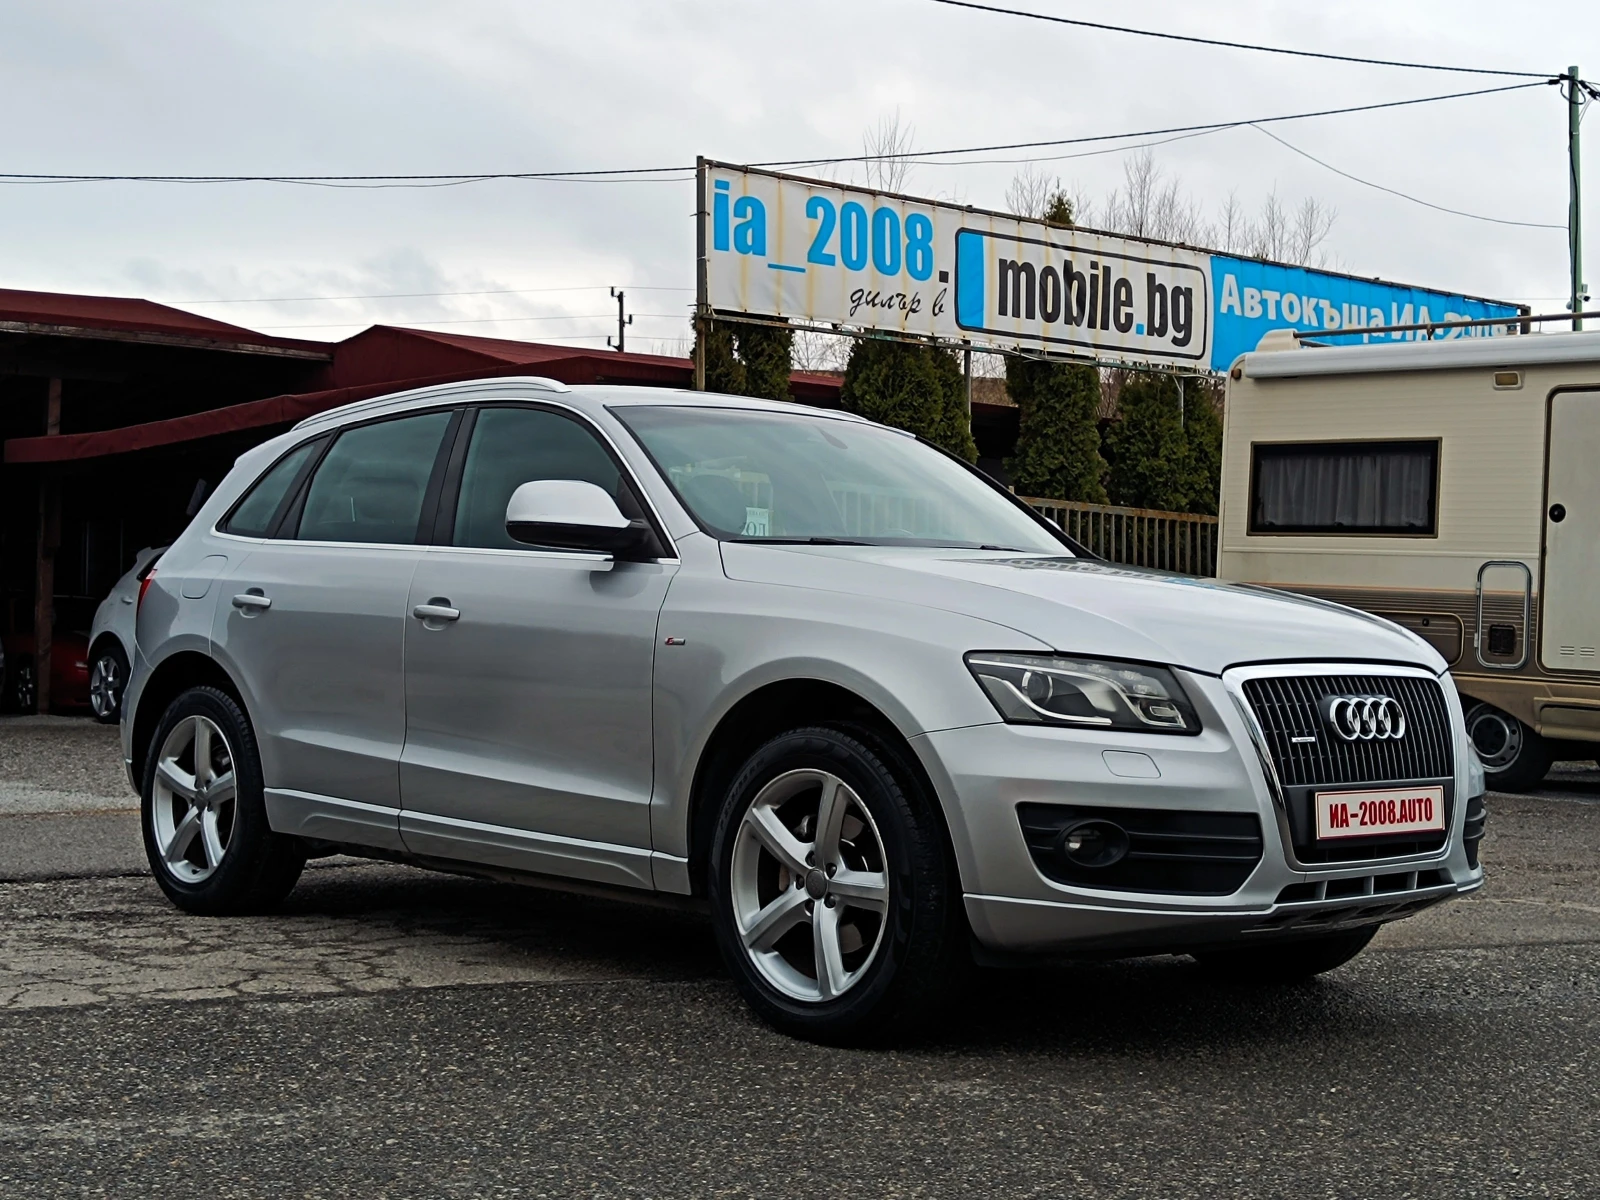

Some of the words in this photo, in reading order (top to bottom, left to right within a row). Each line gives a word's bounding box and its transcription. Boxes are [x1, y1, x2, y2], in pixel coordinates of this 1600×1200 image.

[850, 288, 922, 321] дилър
[932, 287, 947, 317] в
[997, 258, 1193, 347] mobile.bg
[1220, 273, 1385, 343] Автокъща
